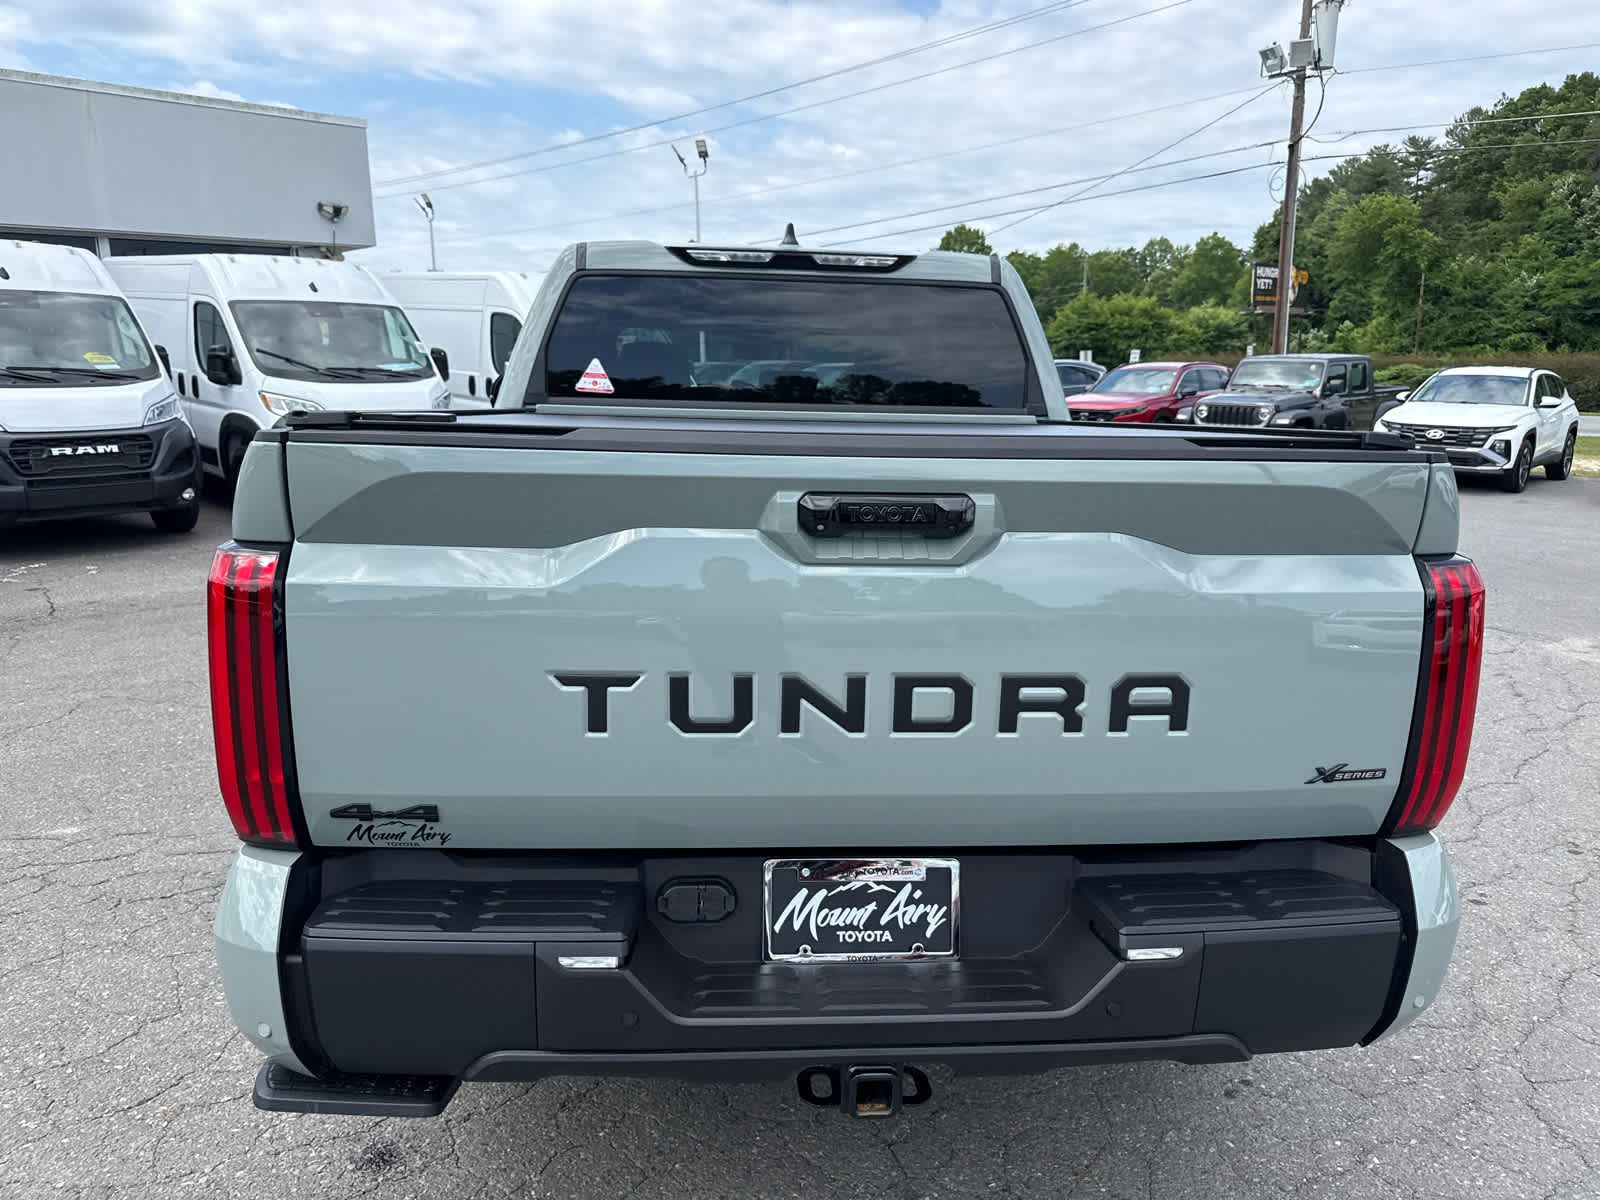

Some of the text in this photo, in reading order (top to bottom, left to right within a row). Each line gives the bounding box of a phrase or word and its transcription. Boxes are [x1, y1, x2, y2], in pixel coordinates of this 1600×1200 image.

[50, 444, 120, 456] RAM
[847, 505, 928, 522] TOYOTA
[546, 670, 1191, 737] TUNDRA
[346, 823, 452, 846] Mount Airy
[773, 882, 948, 942] Mount Airy
[836, 930, 893, 943] TOYOTA
[846, 954, 879, 963] TOYOTA
